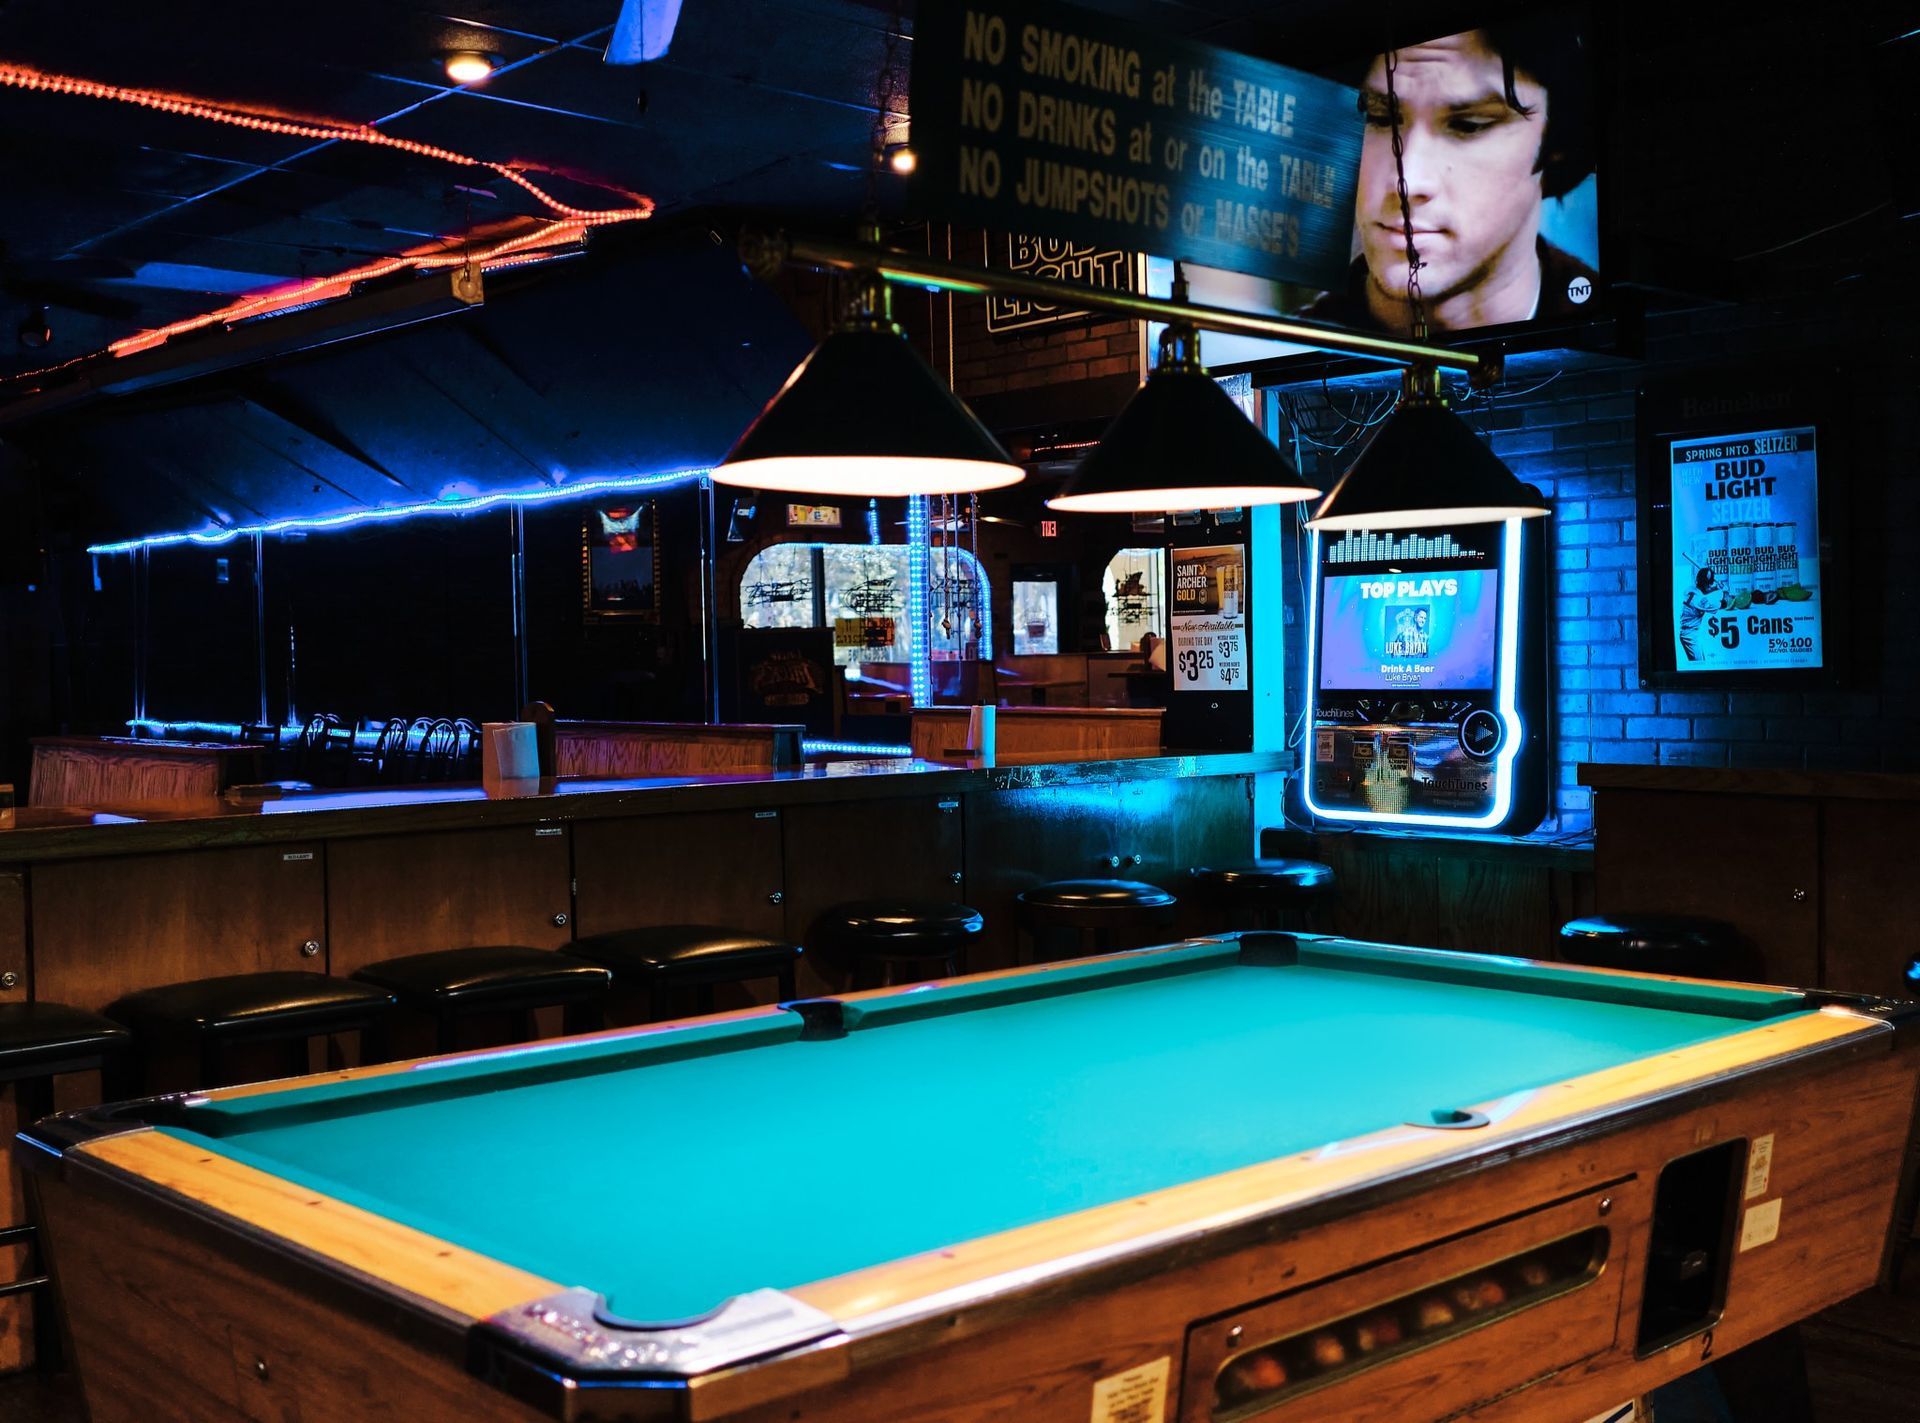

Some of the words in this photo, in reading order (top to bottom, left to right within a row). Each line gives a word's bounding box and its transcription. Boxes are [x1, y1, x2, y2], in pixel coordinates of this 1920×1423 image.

[964, 10, 1006, 65] NO
[1021, 24, 1141, 99] SMOKING
[1153, 65, 1176, 107] at
[1188, 69, 1223, 119] the
[1233, 79, 1296, 138] TABLE
[961, 79, 1002, 132] NO
[1018, 91, 1117, 156] DRINKS
[1129, 121, 1152, 164] at
[1164, 136, 1188, 171] or
[1200, 146, 1225, 181] on
[1236, 146, 1268, 191] the
[960, 146, 1000, 199] NO
[1016, 157, 1169, 231] JUMPSHOTS
[1181, 201, 1204, 239] or
[1009, 232, 1097, 271] BU
[1568, 284, 1592, 298] TNT
[1685, 447, 1722, 462] SPRING
[1726, 444, 1749, 457] INTO
[1754, 435, 1798, 455] SELTZER
[1715, 458, 1766, 481] BUD
[1705, 477, 1776, 501] LIGHT
[1712, 499, 1771, 524] SELTZER
[1731, 547, 1751, 556] BUD
[1754, 546, 1775, 555] BUD
[1777, 544, 1796, 553] BUD
[1177, 563, 1198, 577] SAINT
[1177, 576, 1207, 589] ARCHER
[1361, 581, 1395, 599] TOP
[1398, 579, 1458, 598] PLAYS
[1177, 588, 1195, 601] GOLD
[1196, 620, 1236, 632] Available
[1708, 616, 1740, 649] $5
[1747, 615, 1794, 636] Cans
[1385, 641, 1402, 655] LUKE
[1404, 641, 1427, 655] BRYAN
[1768, 637, 1788, 649] 5%
[1790, 637, 1812, 648] 100
[1381, 664, 1404, 673] Drink
[1406, 664, 1412, 673] A
[1414, 664, 1434, 673] Beer
[1385, 673, 1401, 682] Luke
[1402, 673, 1421, 683] Bryan
[1315, 707, 1354, 719] TouchTunes
[1421, 776, 1488, 791] TouchTunes
[1701, 1330, 1713, 1361] 2
